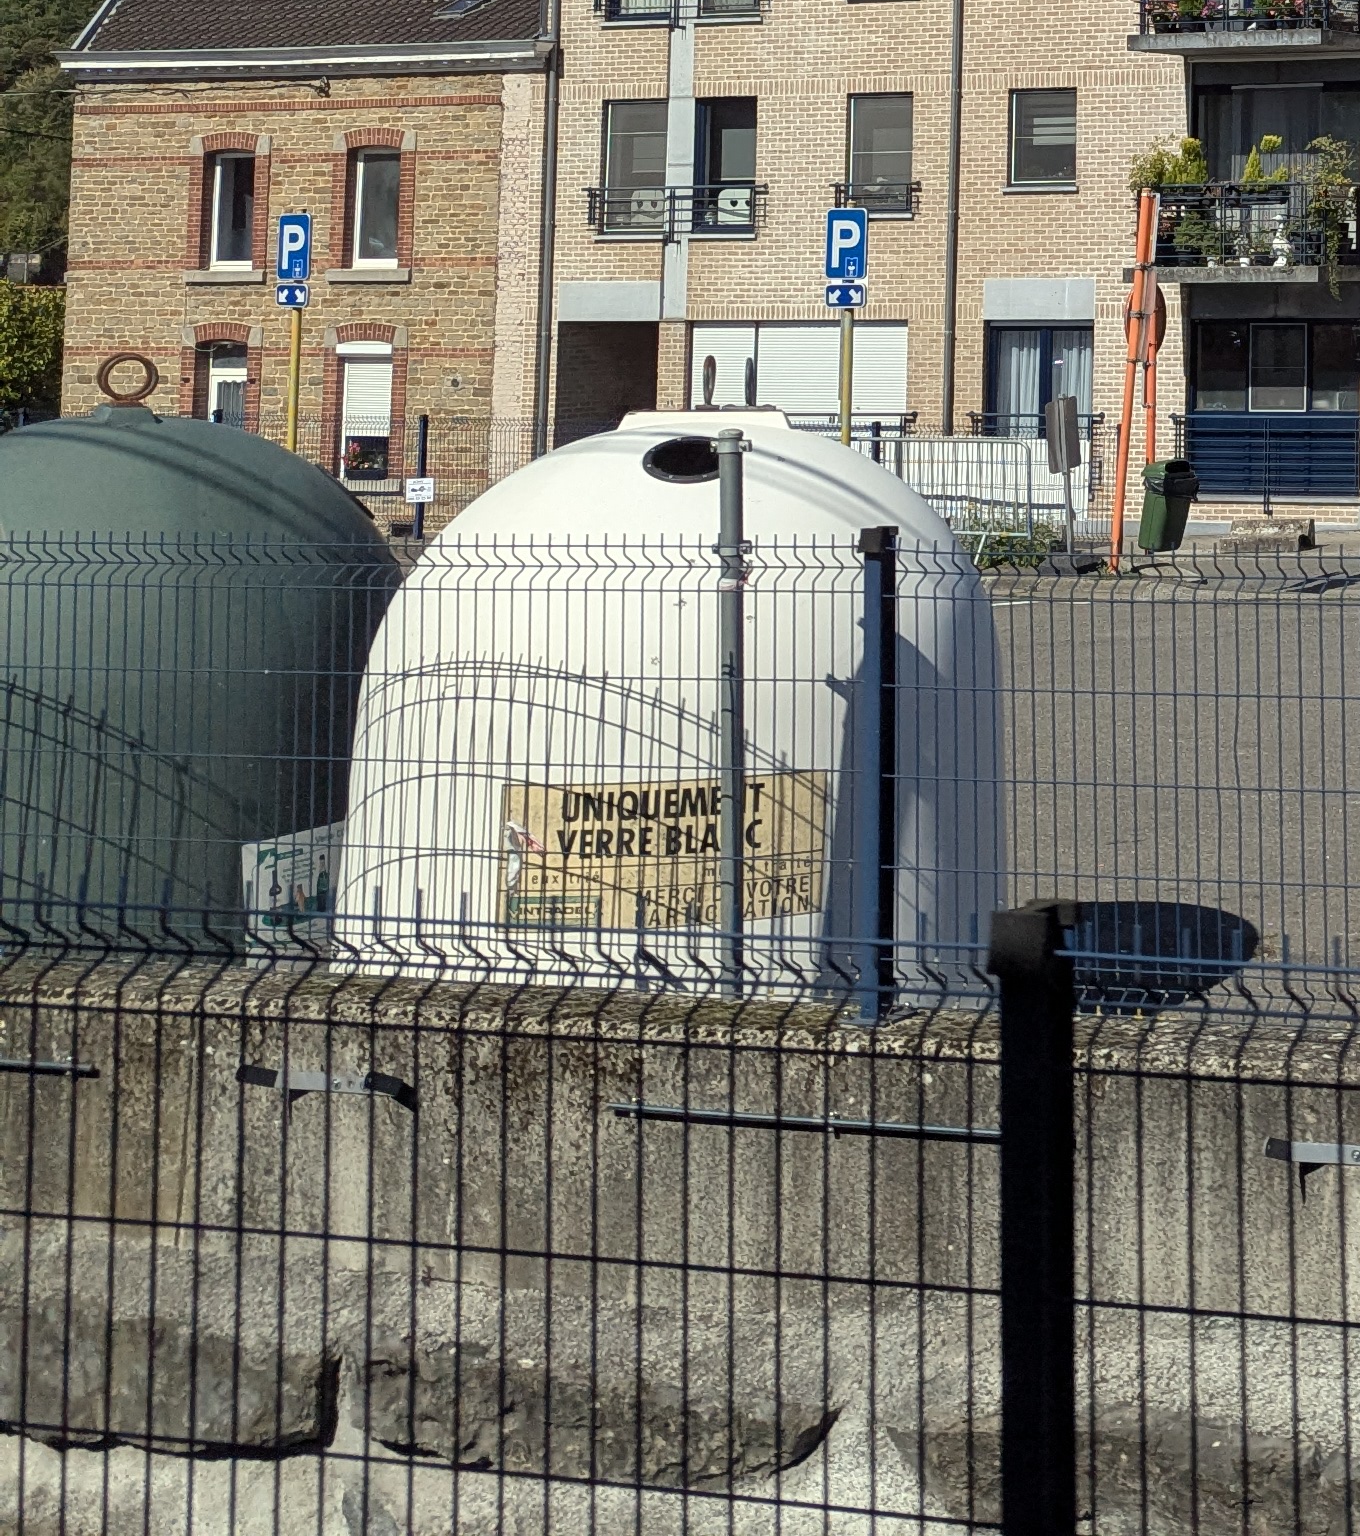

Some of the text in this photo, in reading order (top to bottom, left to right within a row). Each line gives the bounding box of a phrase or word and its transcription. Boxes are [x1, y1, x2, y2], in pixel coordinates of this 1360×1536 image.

[282, 225, 305, 269] P
[831, 220, 860, 268] P
[562, 783, 765, 822] UNIQUEMET
[557, 819, 763, 861] VERRE BLAC
[747, 875, 809, 898] VOTRE
